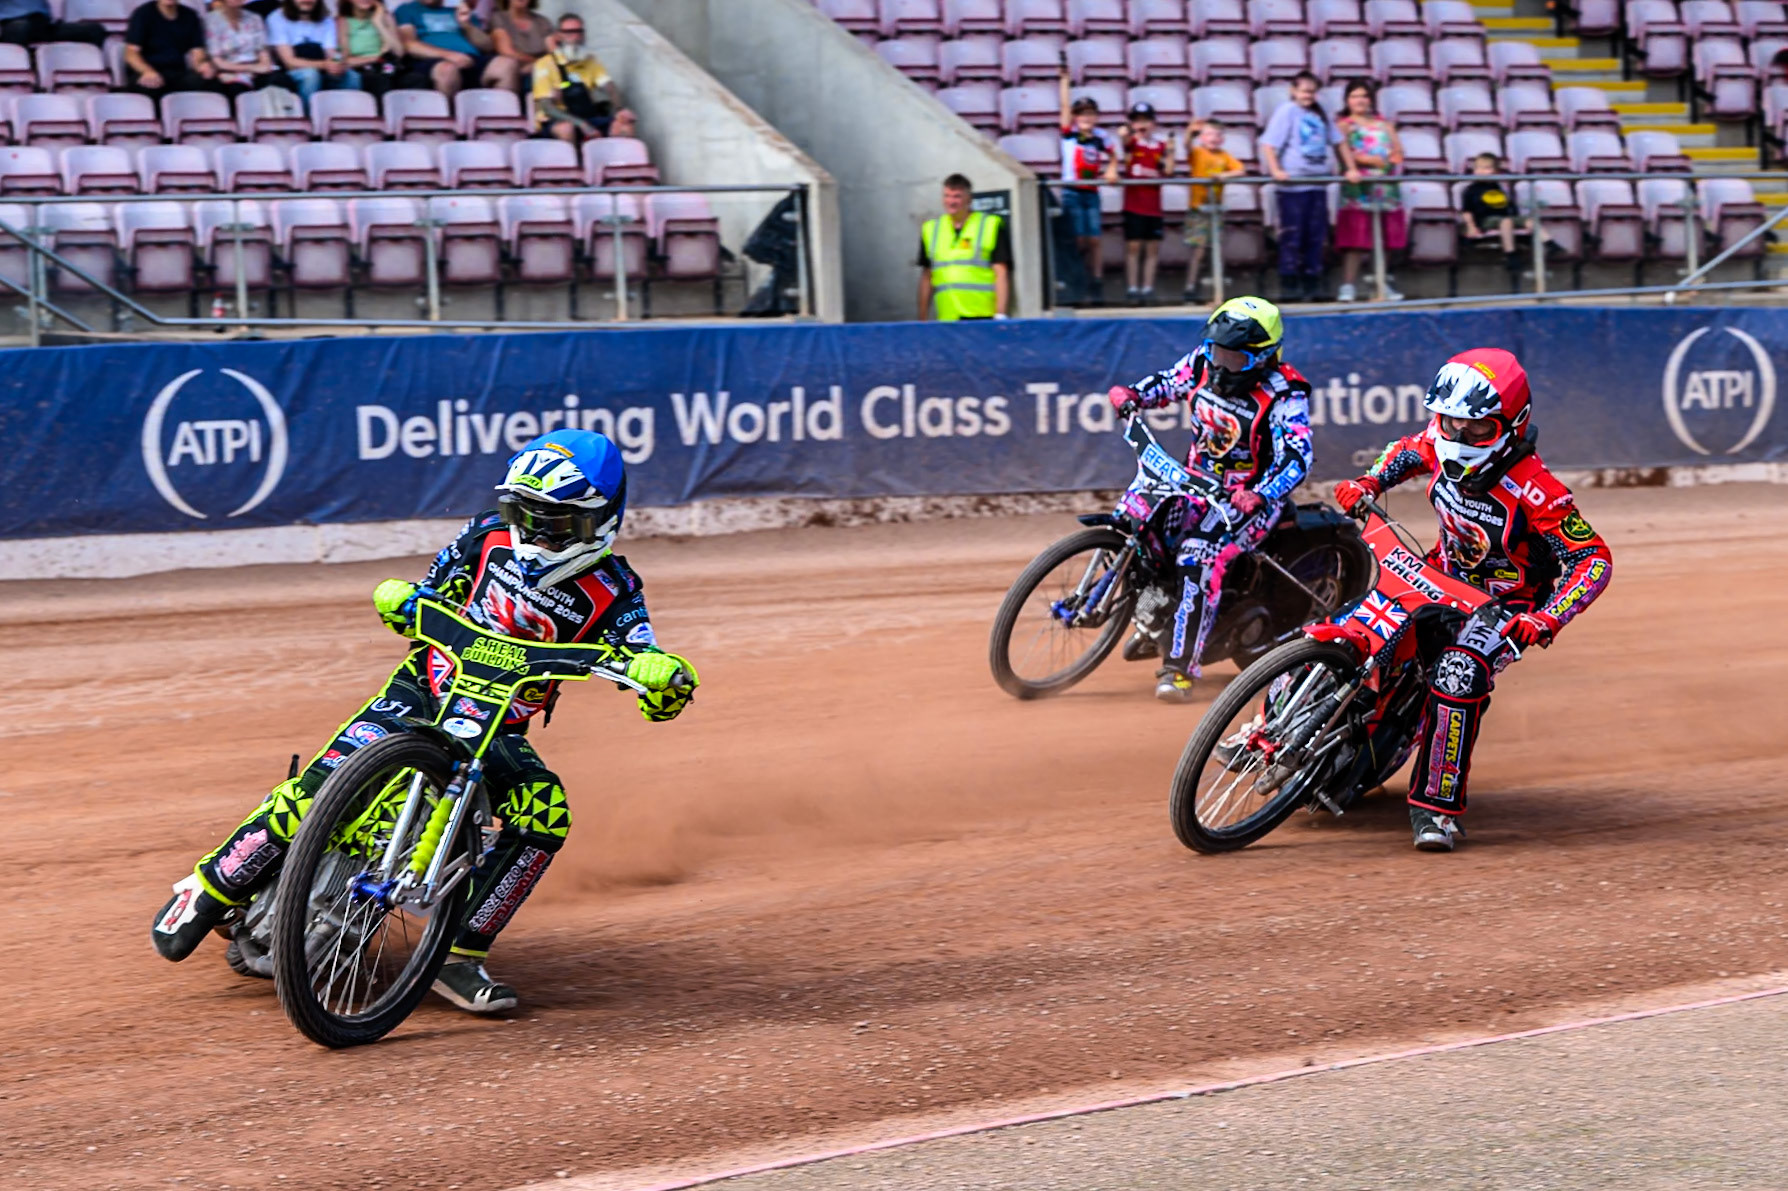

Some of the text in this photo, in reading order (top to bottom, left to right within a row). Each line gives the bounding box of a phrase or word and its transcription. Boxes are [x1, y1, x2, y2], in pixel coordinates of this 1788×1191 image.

[1681, 370, 1754, 410] ATPI
[356, 394, 655, 465] Delivering
[670, 385, 843, 446] World
[861, 384, 1012, 439] Class
[1025, 382, 1193, 433] Trael
[167, 419, 262, 466] ATPI
[1464, 498, 1493, 513] YOUTH
[1391, 547, 1424, 573] KM
[544, 586, 576, 606] OUTH
[1382, 558, 1445, 601] RACING
[553, 604, 585, 624] 2025
[1445, 712, 1462, 762] CARPETS
[1441, 773, 1455, 798] LESS
